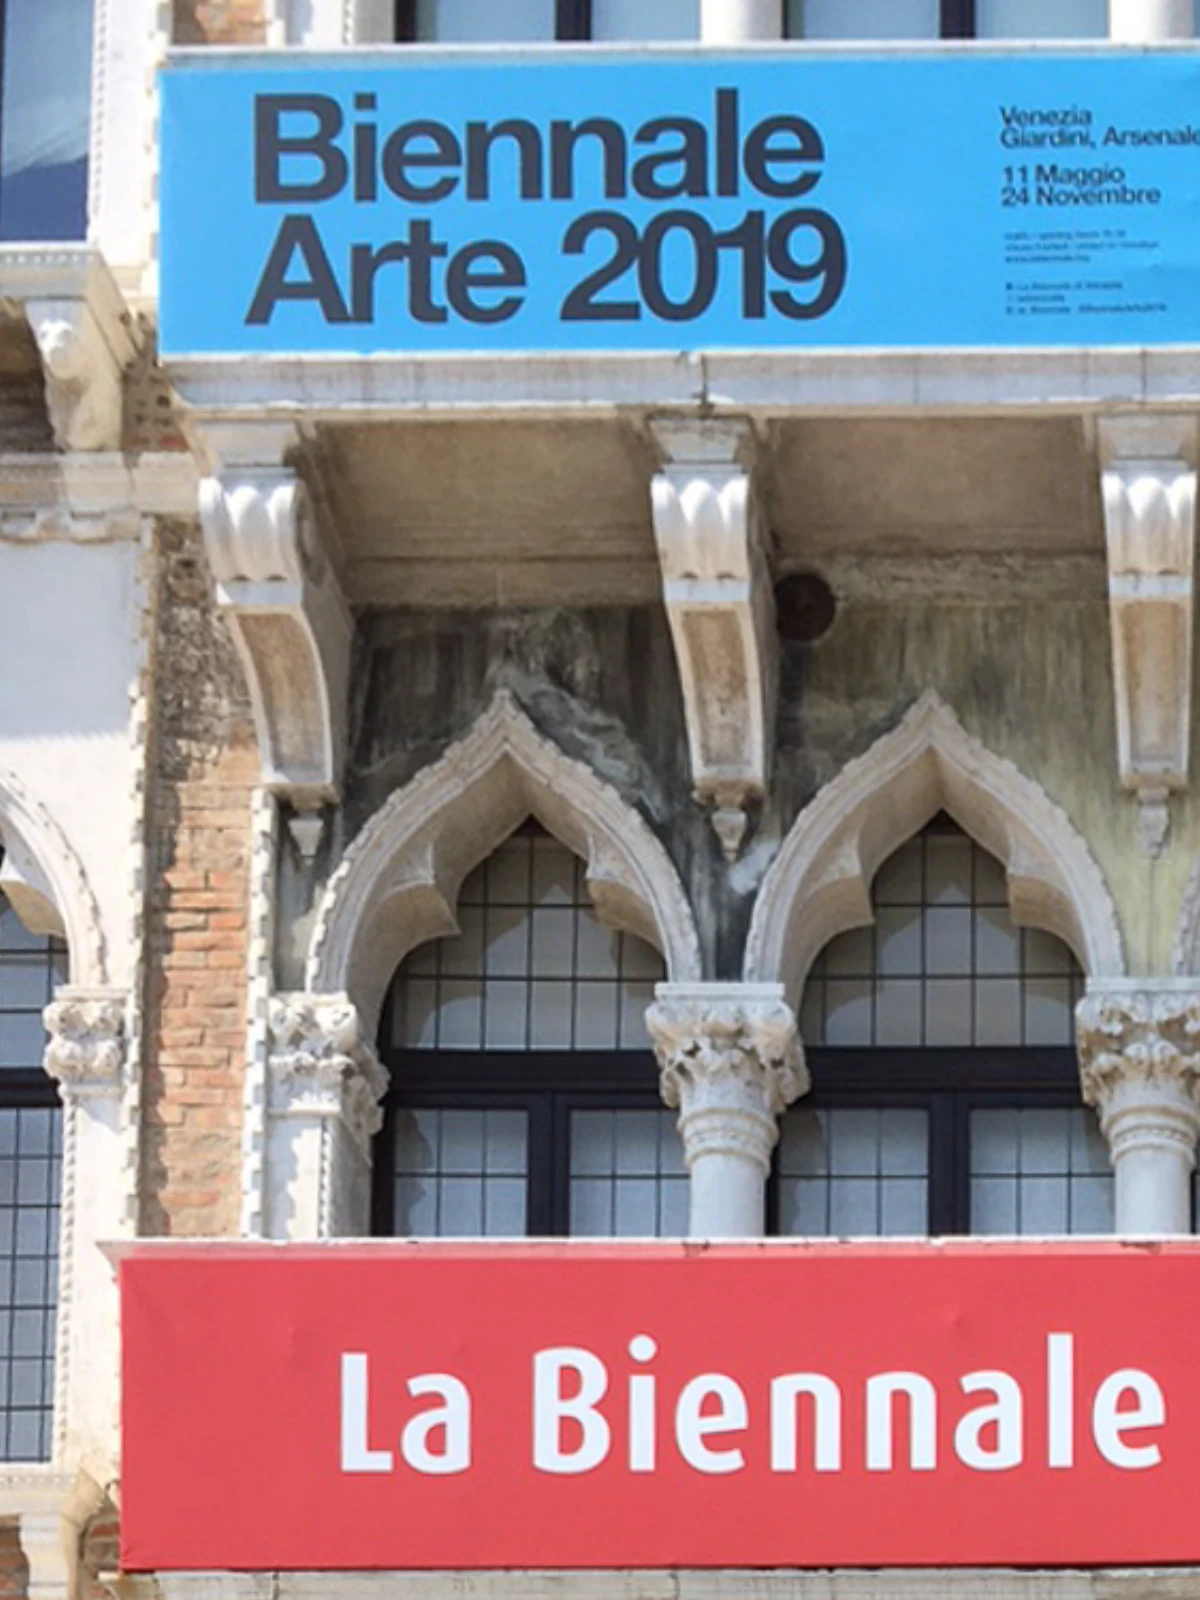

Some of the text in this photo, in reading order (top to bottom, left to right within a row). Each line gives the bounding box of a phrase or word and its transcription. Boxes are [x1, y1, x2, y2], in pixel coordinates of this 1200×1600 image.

[1000, 104, 1092, 126] Venezia
[253, 88, 825, 205] Biennale
[1001, 126, 1096, 149] Giardini,
[1003, 163, 1126, 187] 11 Maggio
[1002, 185, 1162, 207] 24 Novembre
[244, 208, 848, 325] Arte 2019
[340, 1352, 471, 1474] La
[532, 1332, 1166, 1473] Biennale
